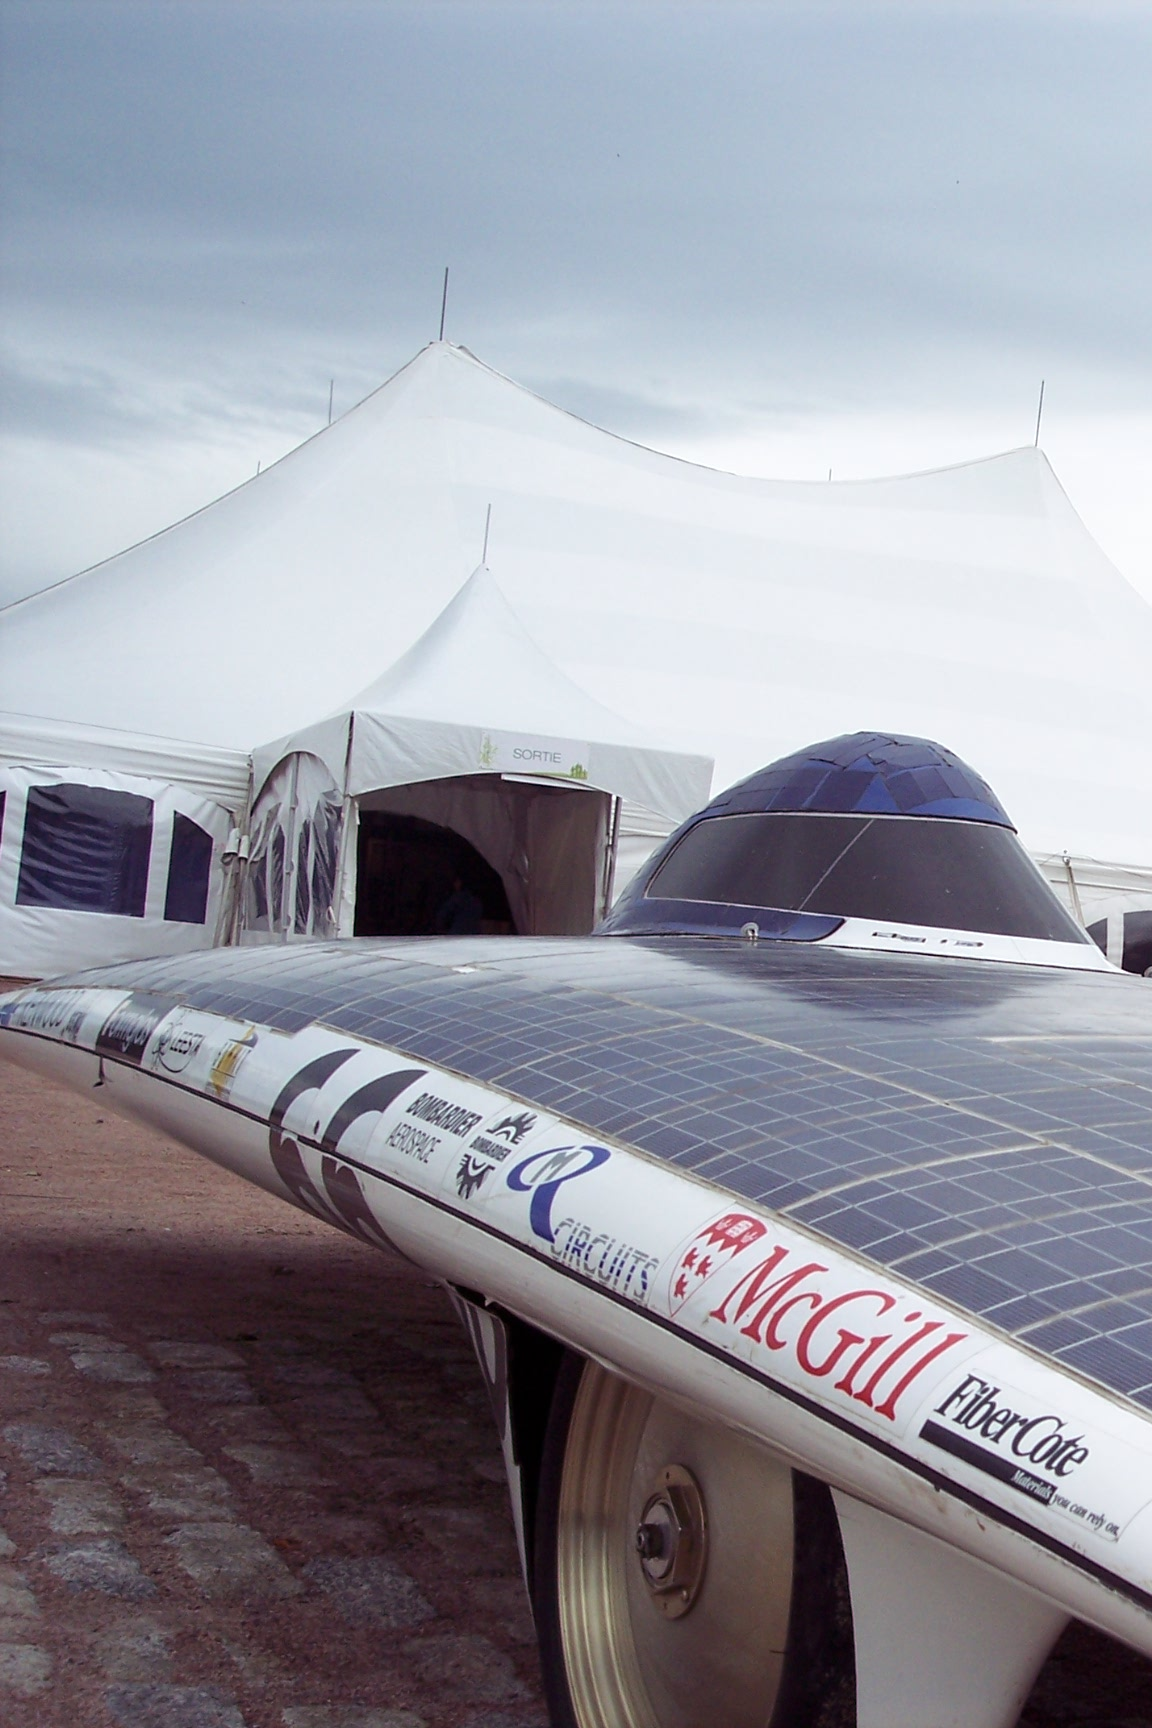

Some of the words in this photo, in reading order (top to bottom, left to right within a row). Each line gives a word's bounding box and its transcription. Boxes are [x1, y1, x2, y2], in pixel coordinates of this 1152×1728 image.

[512, 747, 562, 764] SORTIE
[385, 1122, 442, 1164] AEROSPACE
[405, 1092, 483, 1138] BOMBARDIER
[549, 1217, 660, 1306] CIRCUITS
[709, 1246, 967, 1421] McGill
[933, 1373, 1089, 1477] FiberCote
[1011, 1469, 1054, 1500] Materials
[1051, 1493, 1071, 1510] you
[1069, 1503, 1088, 1518] can
[1086, 1513, 1107, 1531] rely
